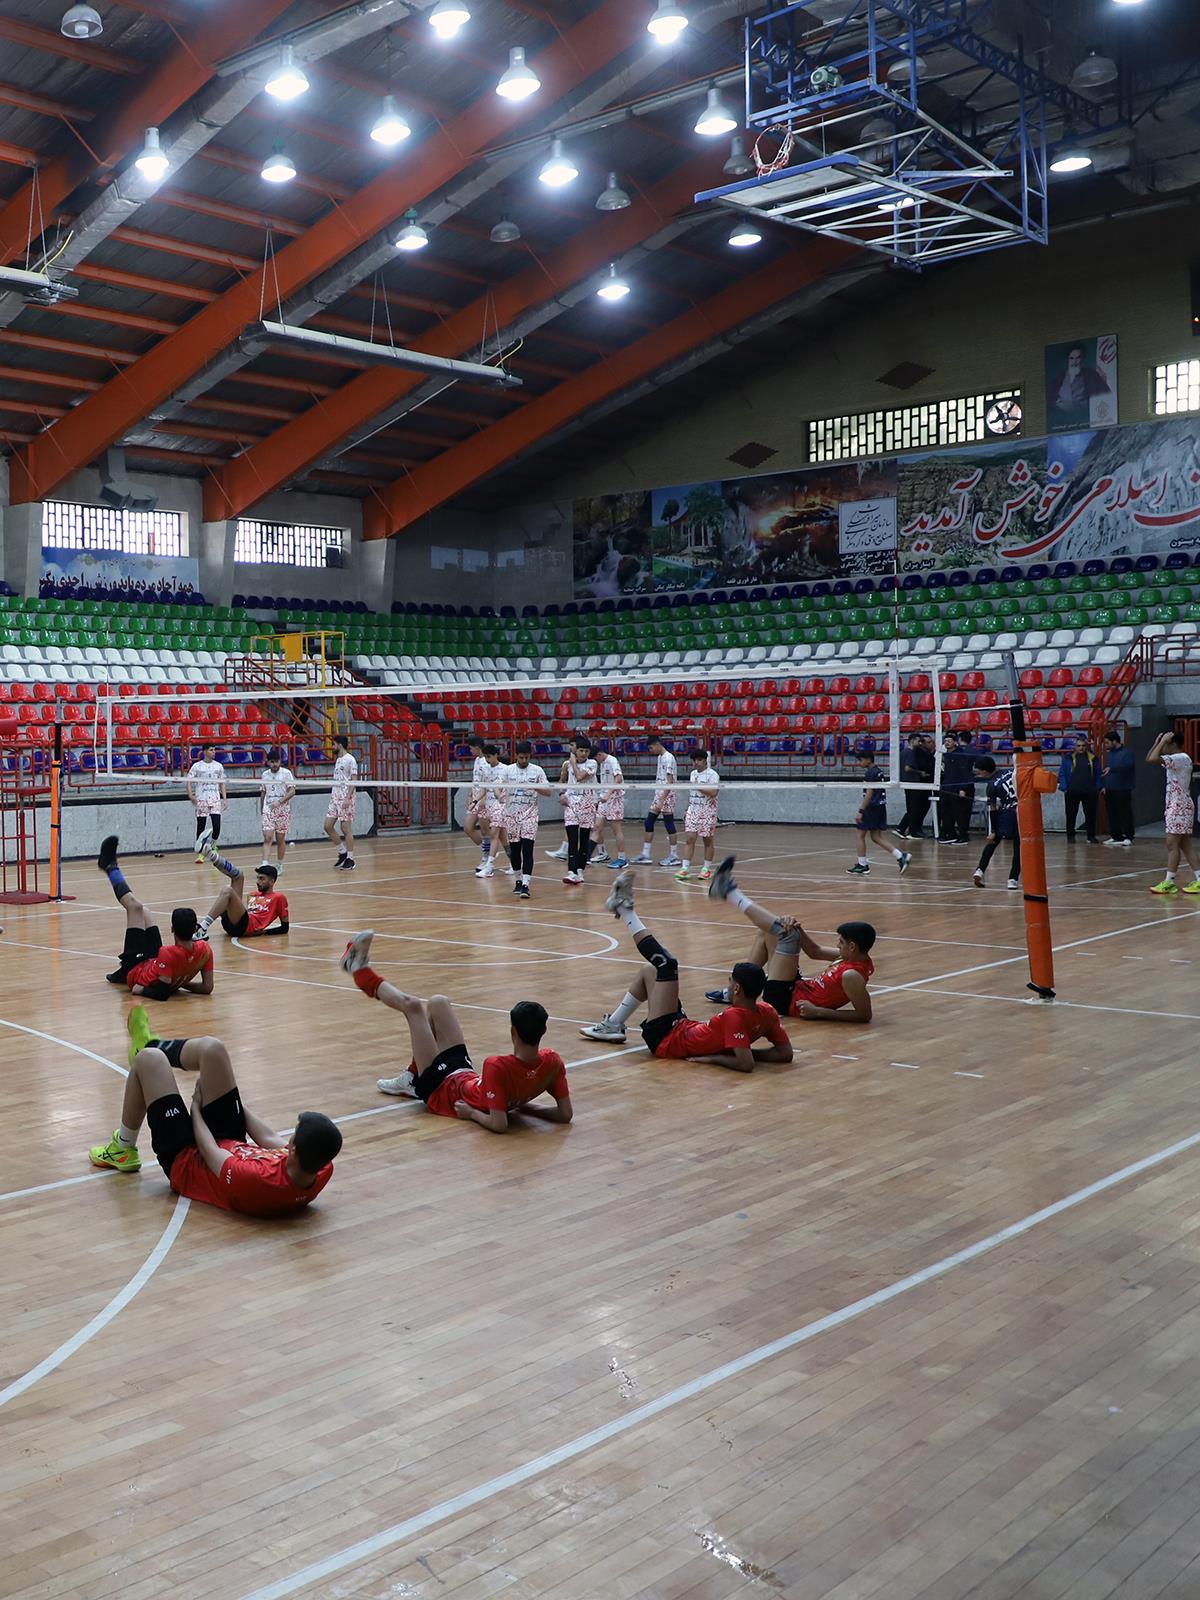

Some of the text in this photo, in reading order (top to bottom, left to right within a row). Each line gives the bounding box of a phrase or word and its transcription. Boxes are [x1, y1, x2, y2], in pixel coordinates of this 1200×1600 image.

[902, 469, 981, 553] آمدید
[975, 461, 1065, 541] خوش
[1001, 472, 1168, 558] اسلامی
